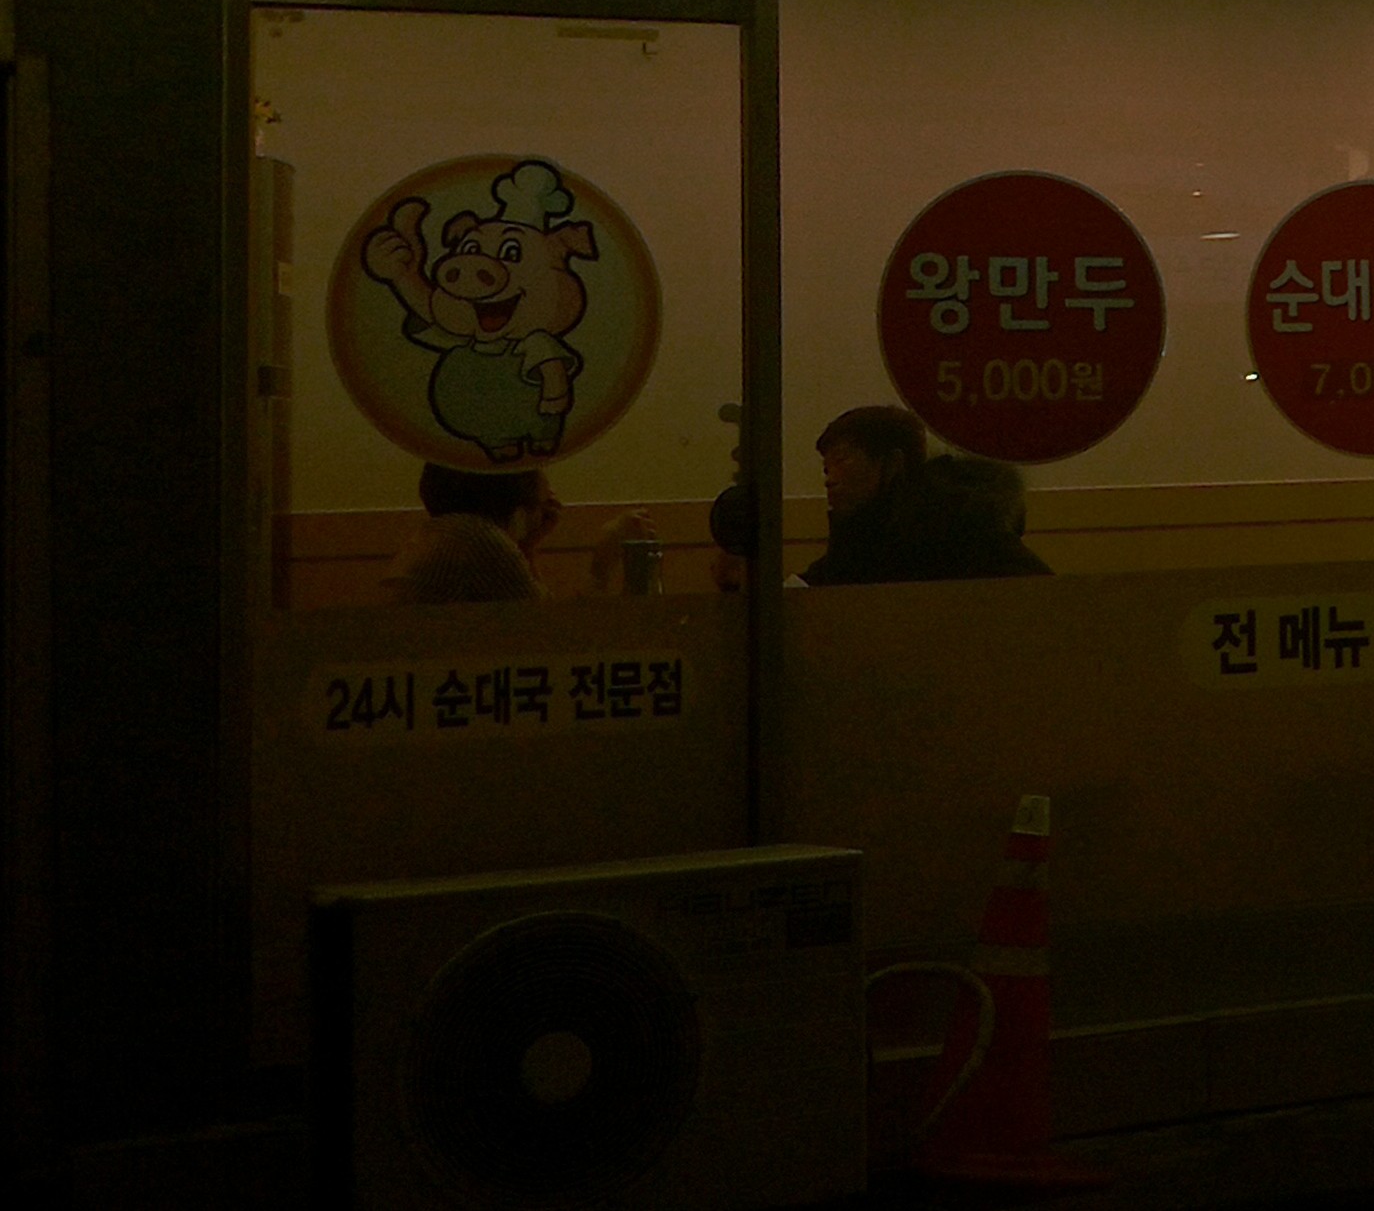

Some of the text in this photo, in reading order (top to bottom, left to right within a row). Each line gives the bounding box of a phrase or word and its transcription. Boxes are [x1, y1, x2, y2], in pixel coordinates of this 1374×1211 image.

[905, 251, 1136, 335] 왕만두
[1211, 607, 1259, 675] 전
[1278, 605, 1370, 671] 메뉴
[326, 658, 682, 731] 24시 순대국 전문점
